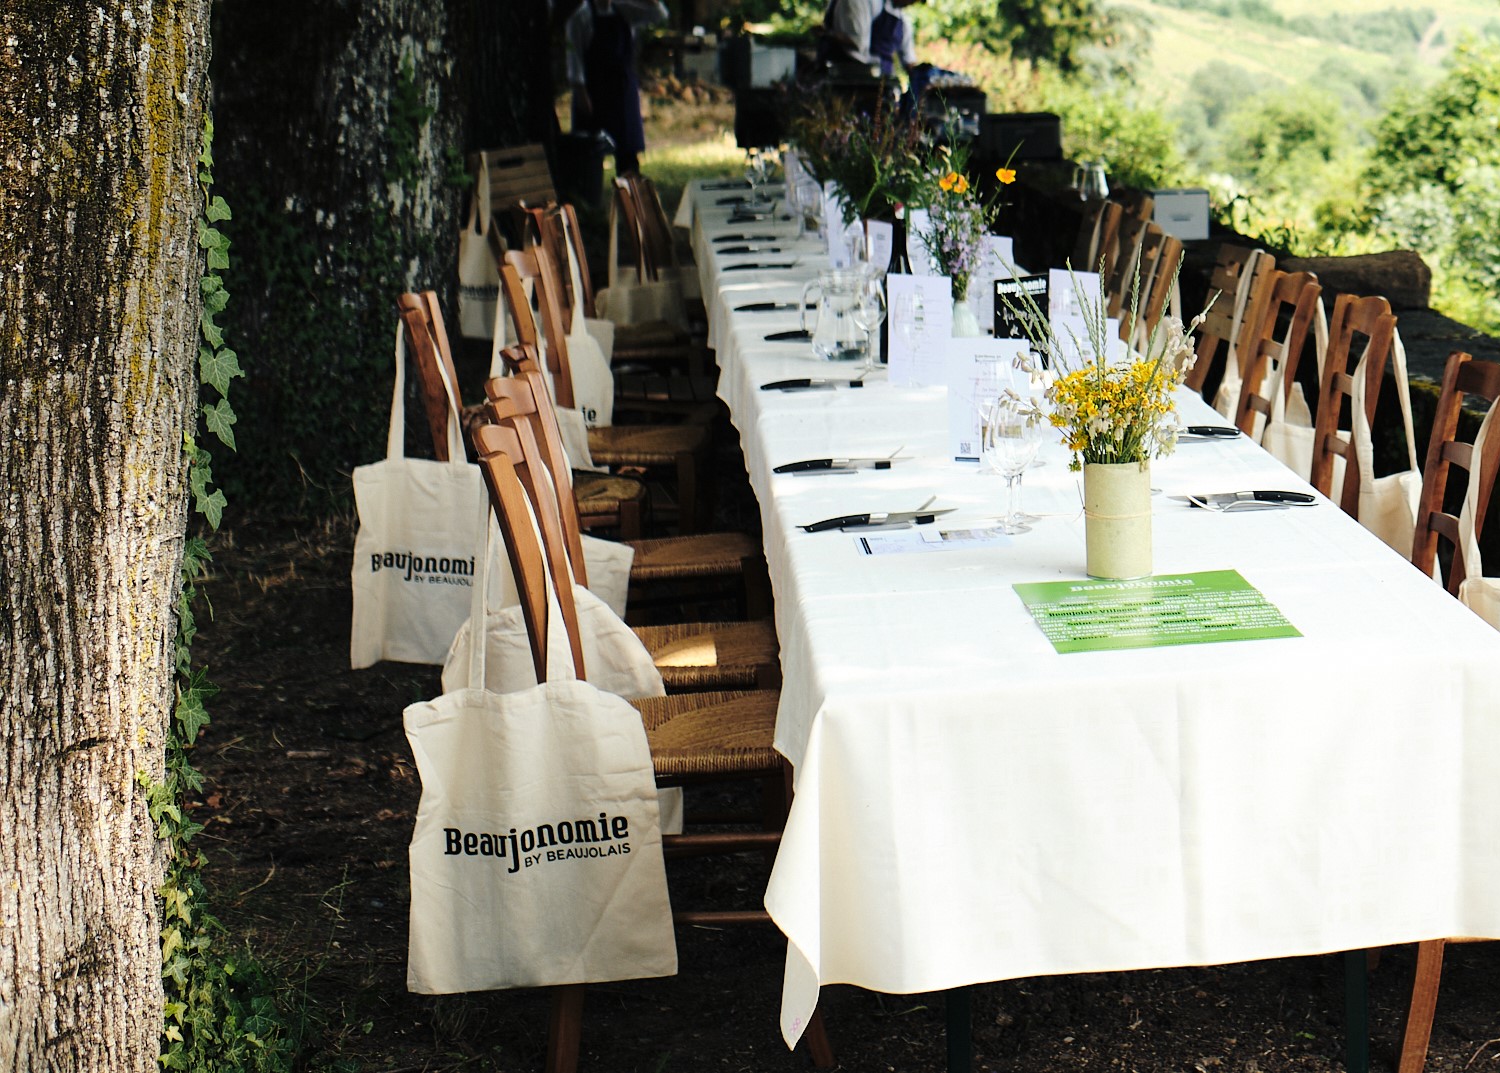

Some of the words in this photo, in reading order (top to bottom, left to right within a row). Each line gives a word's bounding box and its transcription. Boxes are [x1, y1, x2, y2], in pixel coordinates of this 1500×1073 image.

[371, 551, 475, 582] Baujonomi
[428, 576, 473, 587] BEAUJOL
[443, 812, 629, 873] Beaujonomie
[524, 853, 541, 868] BY
[547, 842, 631, 862] BEAUJOLAIS
